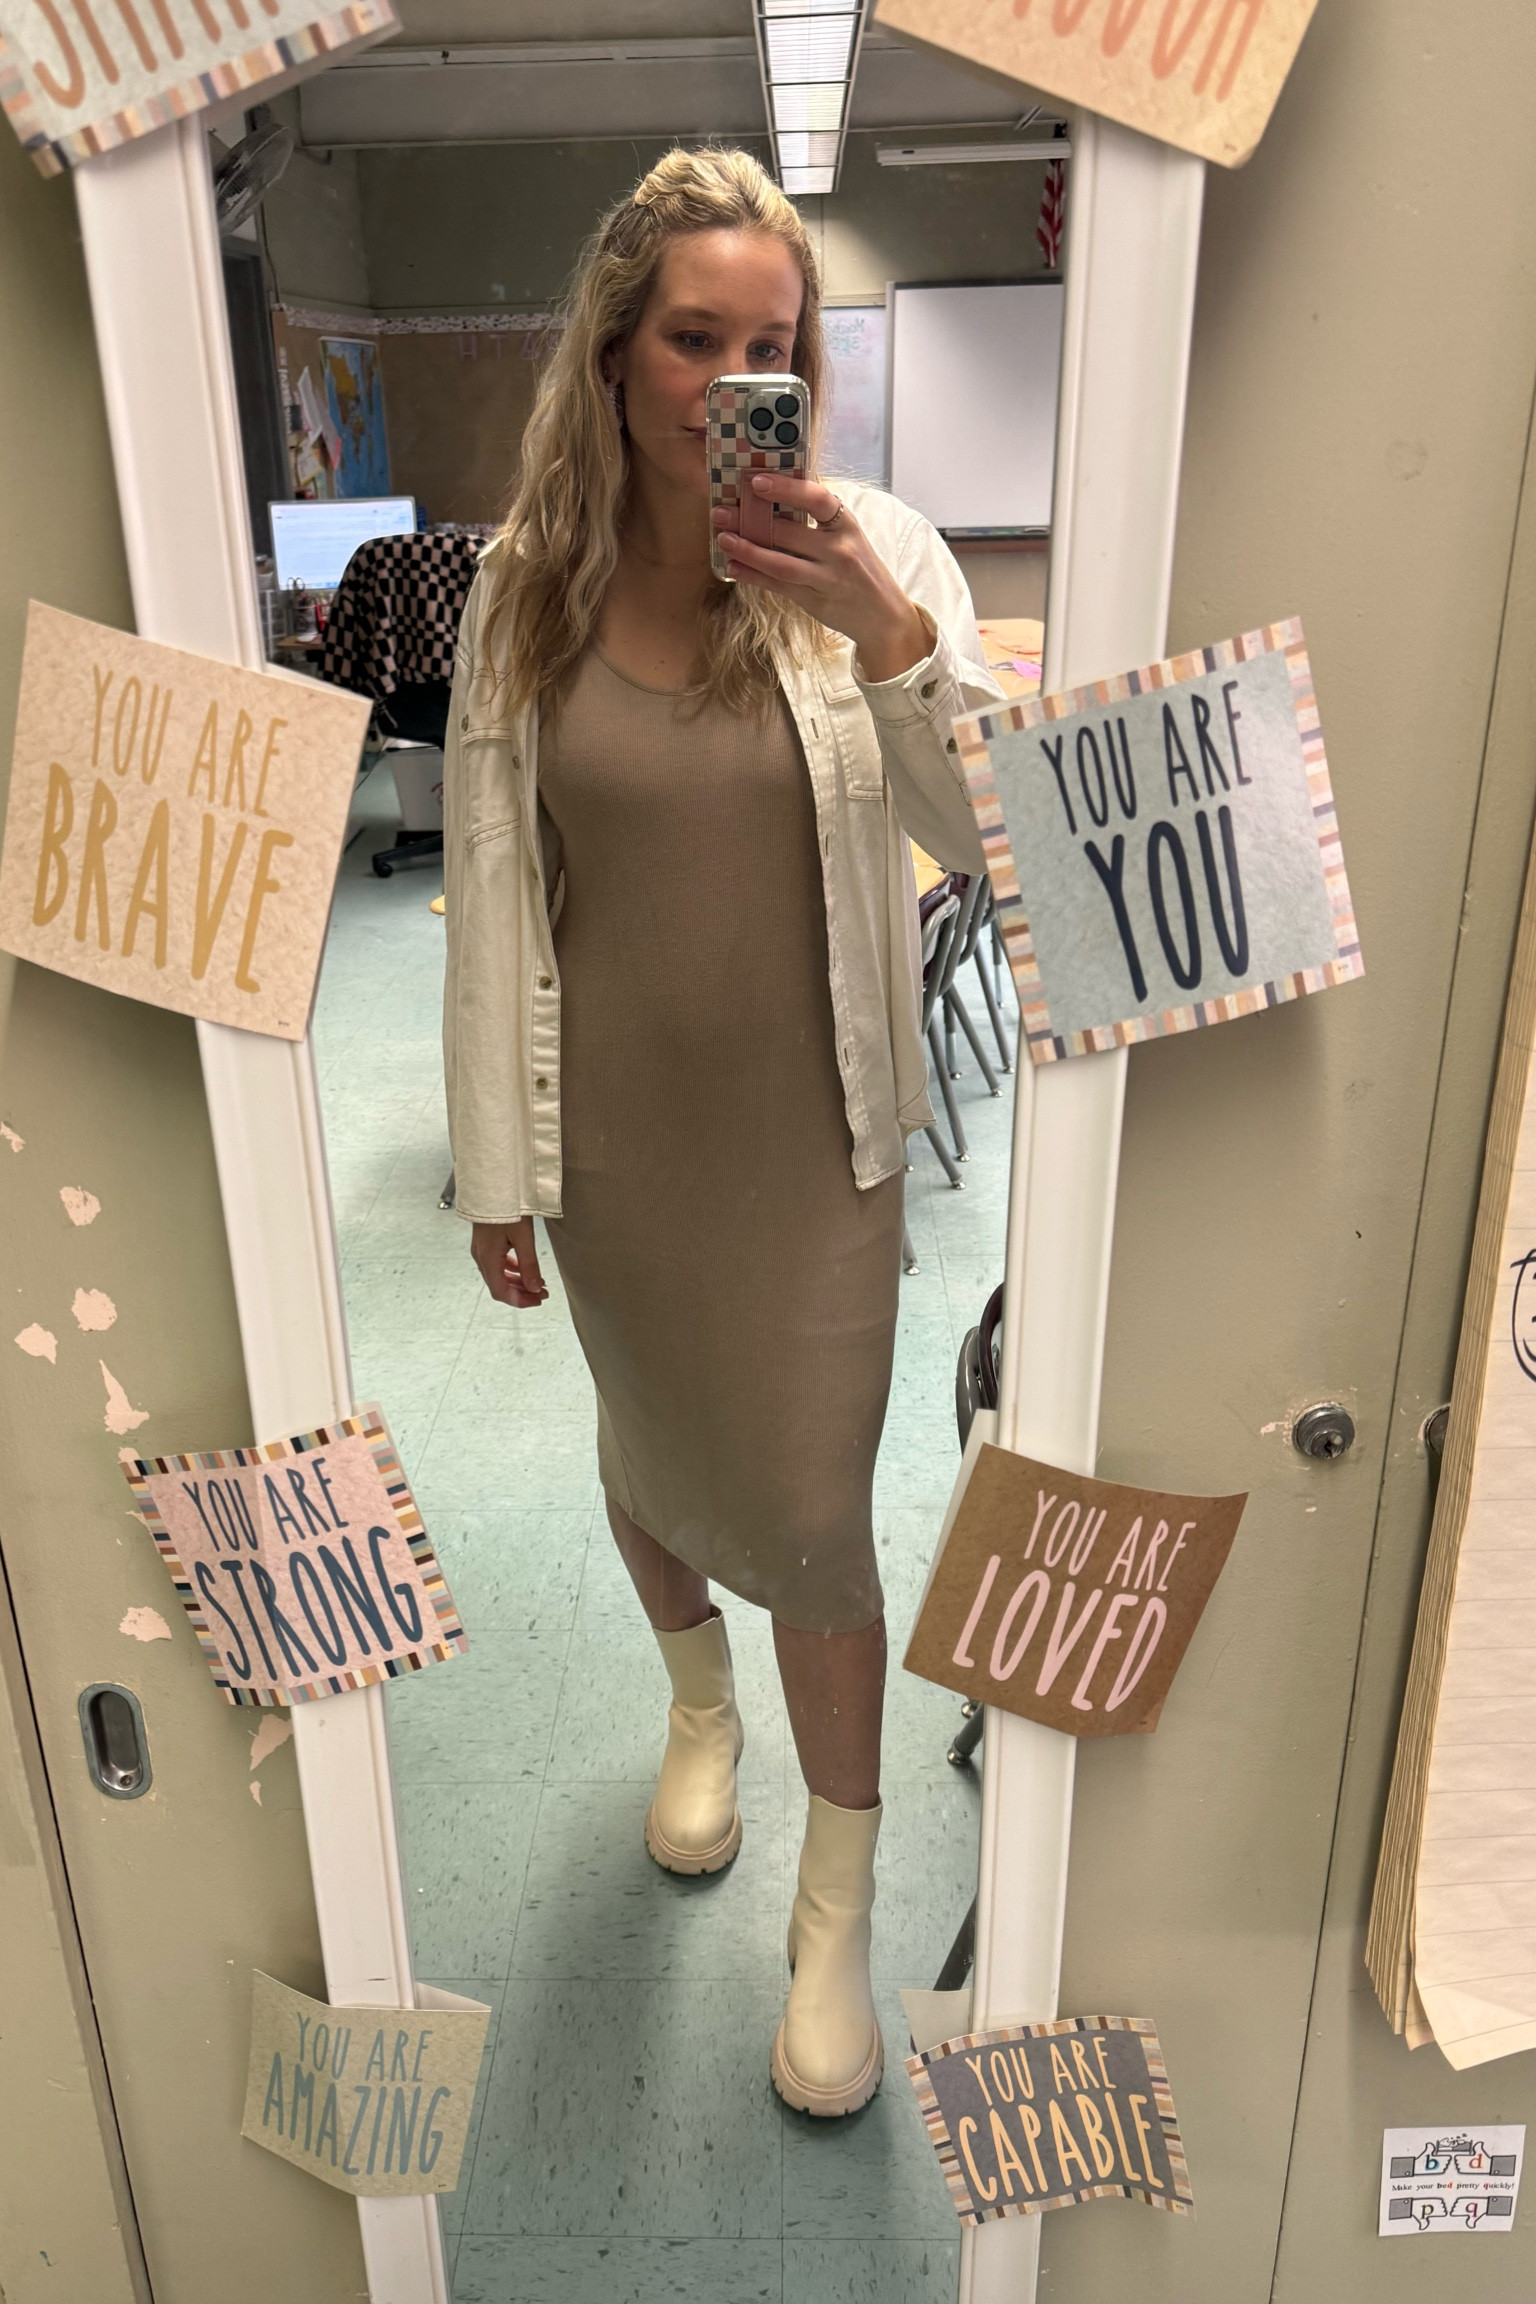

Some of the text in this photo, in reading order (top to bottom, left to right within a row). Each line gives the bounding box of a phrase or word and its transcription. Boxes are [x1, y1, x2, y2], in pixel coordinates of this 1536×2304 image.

[91, 664, 288, 818] YOU ARE
[1039, 680, 1252, 836] YOU ARE
[33, 762, 294, 994] BRAVE
[1084, 804, 1250, 1003] YOU
[181, 1457, 350, 1552] YOU ARE
[1023, 1489, 1197, 1592] YOU ARE
[195, 1526, 423, 1681] STRONG
[952, 1554, 1168, 1712] LOVED
[297, 2011, 433, 2082] YOU ARE
[965, 2036, 1117, 2107] YOU ARE
[262, 2051, 451, 2175] AMAZING
[959, 2092, 1165, 2202] CAPABLE
[1425, 2153, 1484, 2171] b d
[1416, 2183, 1434, 2191] your
[1436, 2182, 1453, 2190] bed
[1456, 2183, 1479, 2191] pretty
[1421, 2202, 1478, 2219] p q
